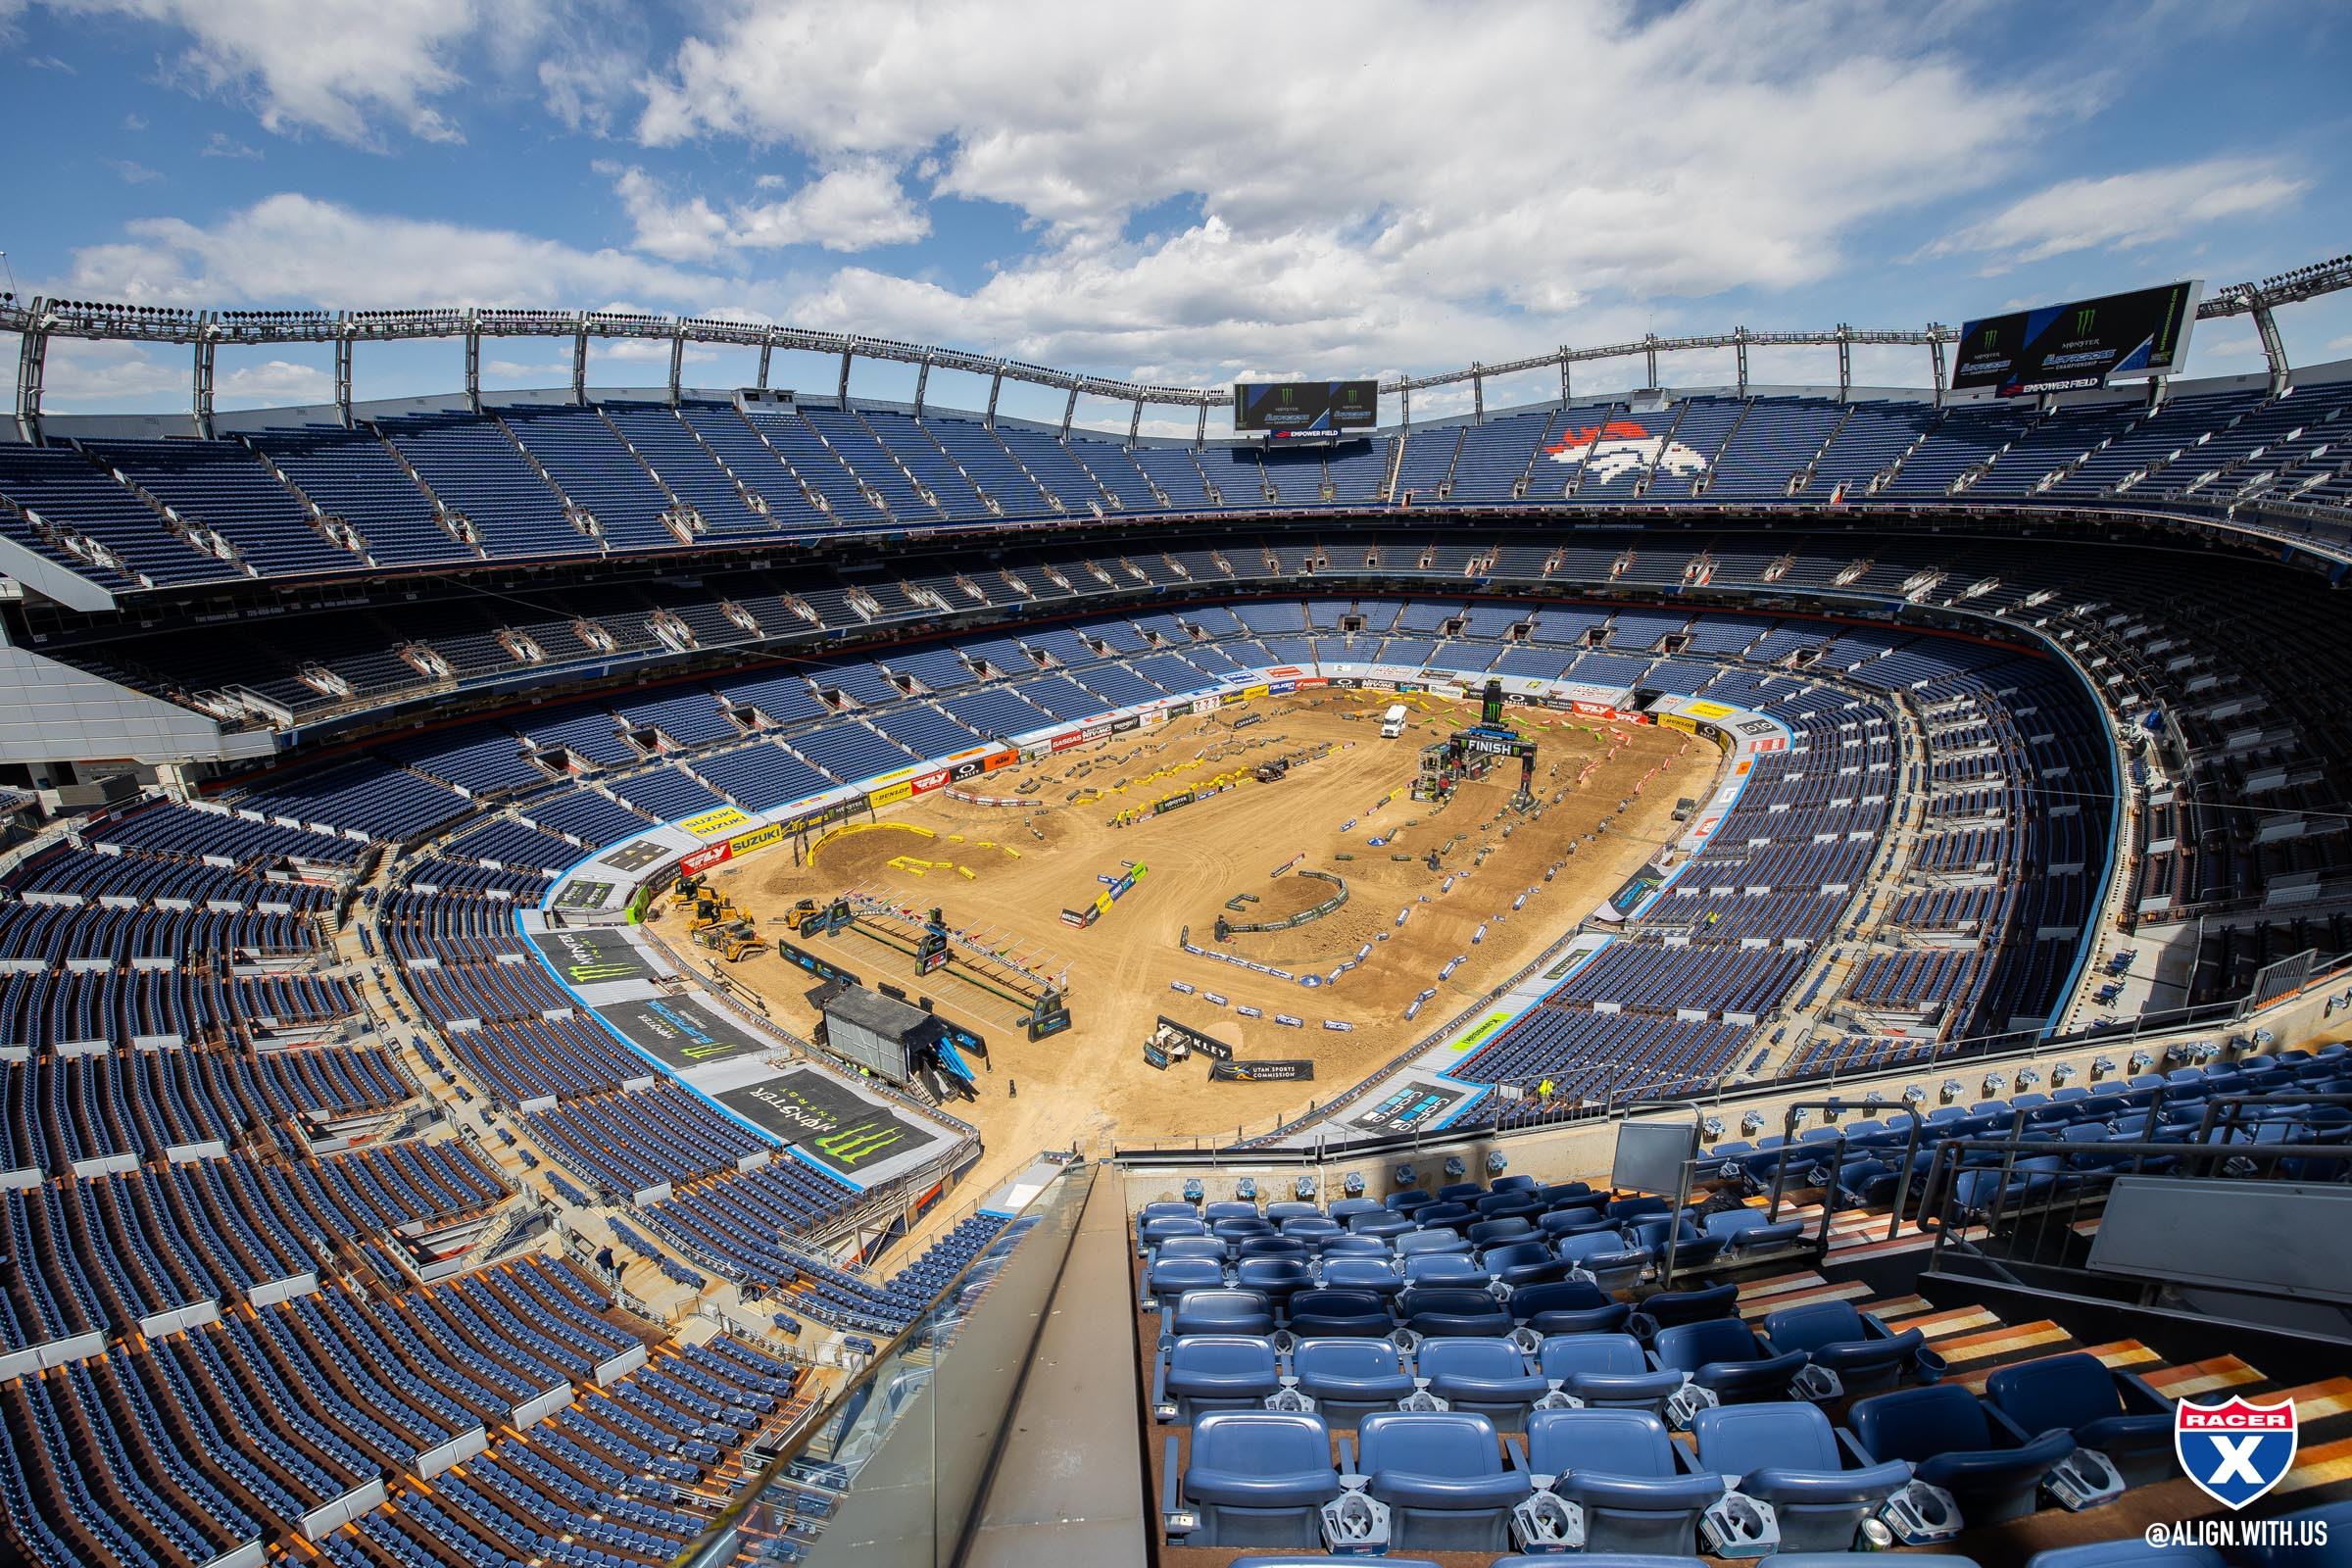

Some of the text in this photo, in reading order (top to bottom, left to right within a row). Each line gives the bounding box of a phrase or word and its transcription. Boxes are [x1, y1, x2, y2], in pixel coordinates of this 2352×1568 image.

[2023, 378, 2098, 393] EMPOWER FIELD
[1270, 682, 1295, 690] FALKEN
[1577, 703, 1610, 714] FLY
[1666, 717, 1694, 728] DUNLOP
[1052, 735, 1082, 748] GASGAS
[1468, 740, 1512, 755] FINISH
[995, 755, 1010, 765] KTM
[913, 772, 947, 790] FLY
[956, 769, 980, 780] OAKLEY
[878, 786, 910, 801] DUNLOP
[1165, 796, 1187, 808] MONSTER
[685, 808, 736, 828] SUZUKI
[696, 815, 748, 835] SUZUKI
[732, 828, 780, 853] SUZUKI
[683, 845, 727, 868] FLY
[666, 867, 681, 877] SPORTS
[558, 933, 594, 965] MONSTER
[637, 1014, 676, 1039] MONSTER
[1462, 1018, 1501, 1045] Kawasaki
[749, 1087, 838, 1132] MONSTER
[779, 1087, 838, 1122] ENERGY
[1372, 1091, 1423, 1123] GoPro
